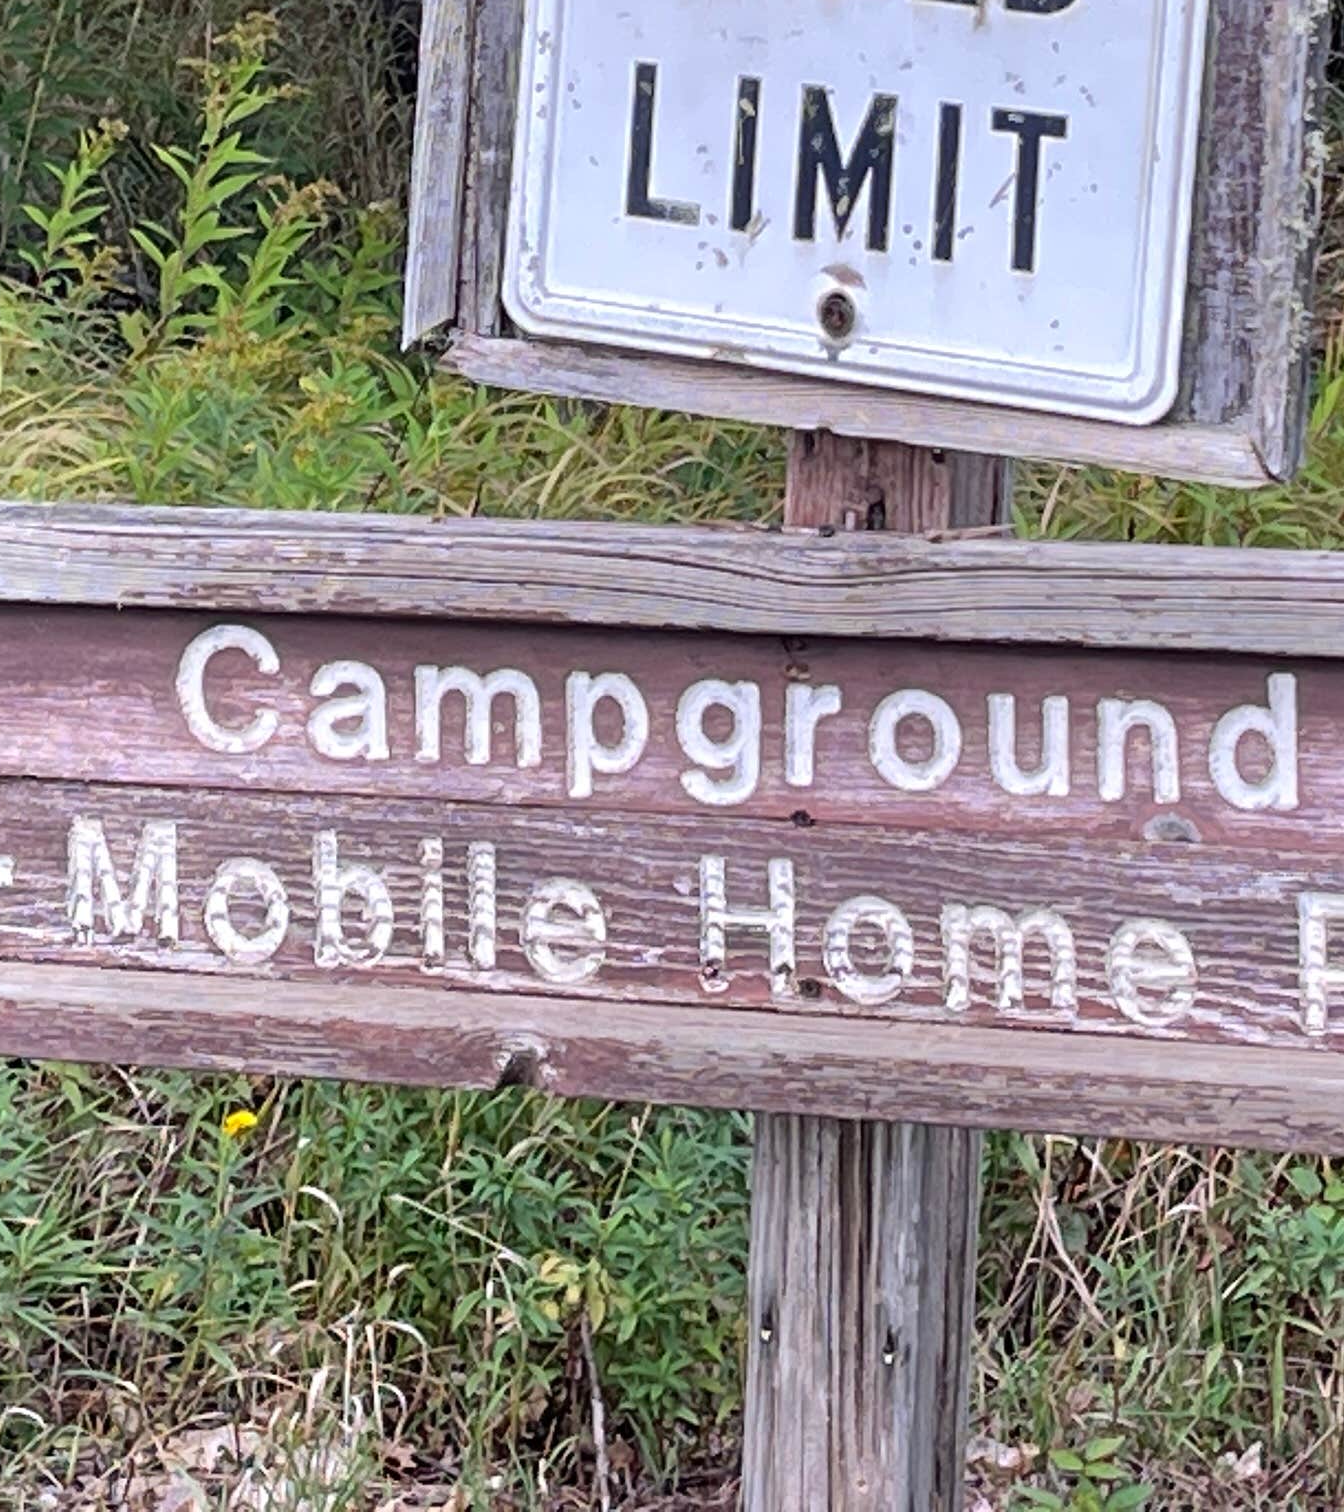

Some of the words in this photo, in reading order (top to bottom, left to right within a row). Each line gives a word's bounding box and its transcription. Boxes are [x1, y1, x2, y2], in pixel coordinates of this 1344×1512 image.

[624, 61, 1068, 273] LIMIT
[175, 623, 1300, 811] Campground
[66, 813, 607, 984] Mobile
[698, 854, 1197, 1026] Home
